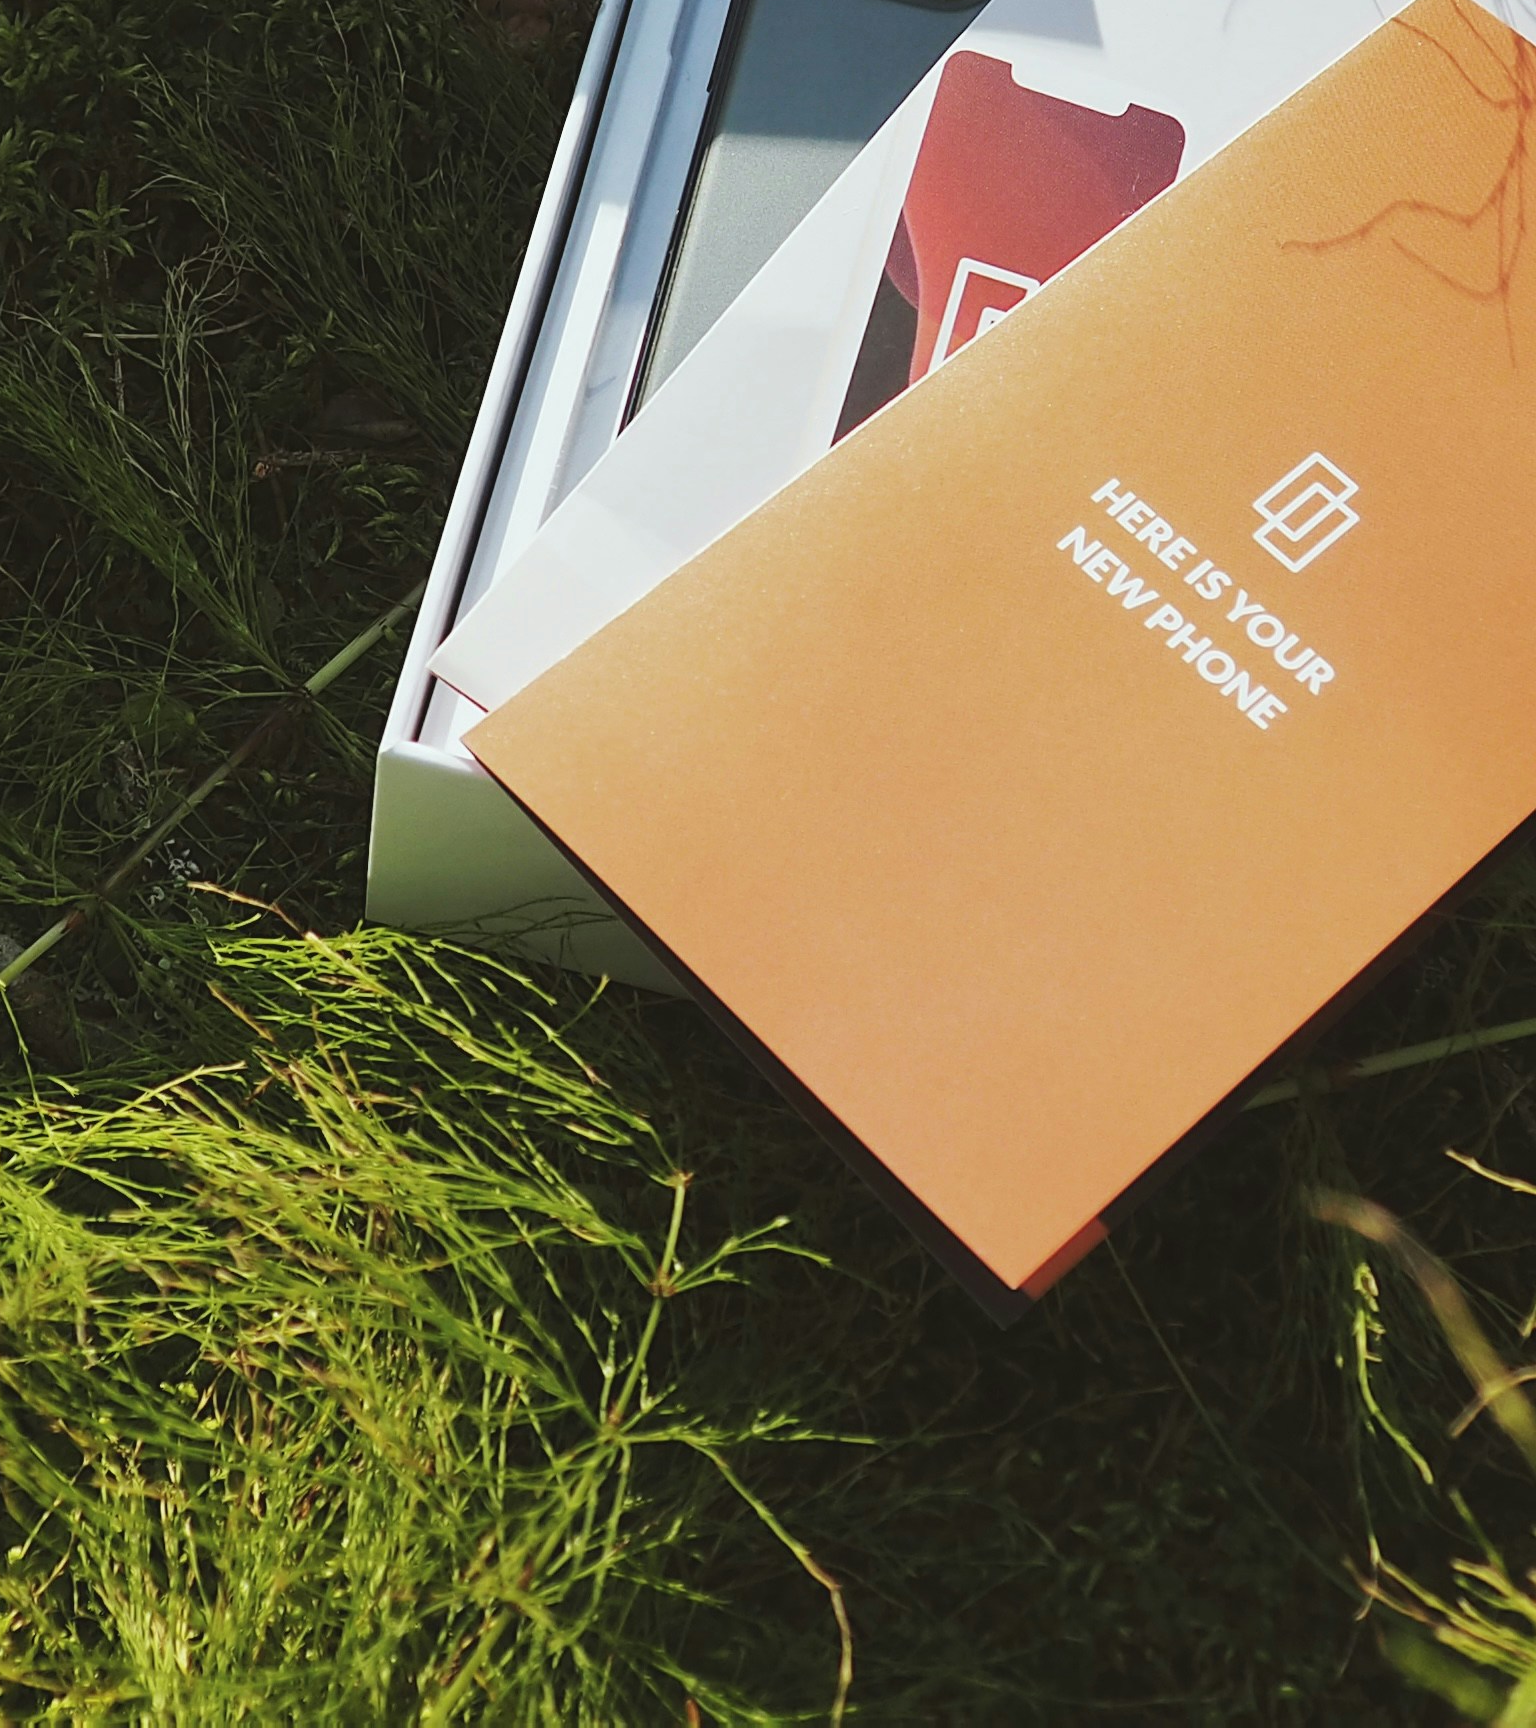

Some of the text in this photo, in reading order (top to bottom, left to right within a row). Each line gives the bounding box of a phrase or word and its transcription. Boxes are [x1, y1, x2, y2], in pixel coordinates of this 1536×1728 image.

[1056, 525, 1288, 730] NEW PHONE
[1090, 478, 1335, 696] HERE IS YOUR
